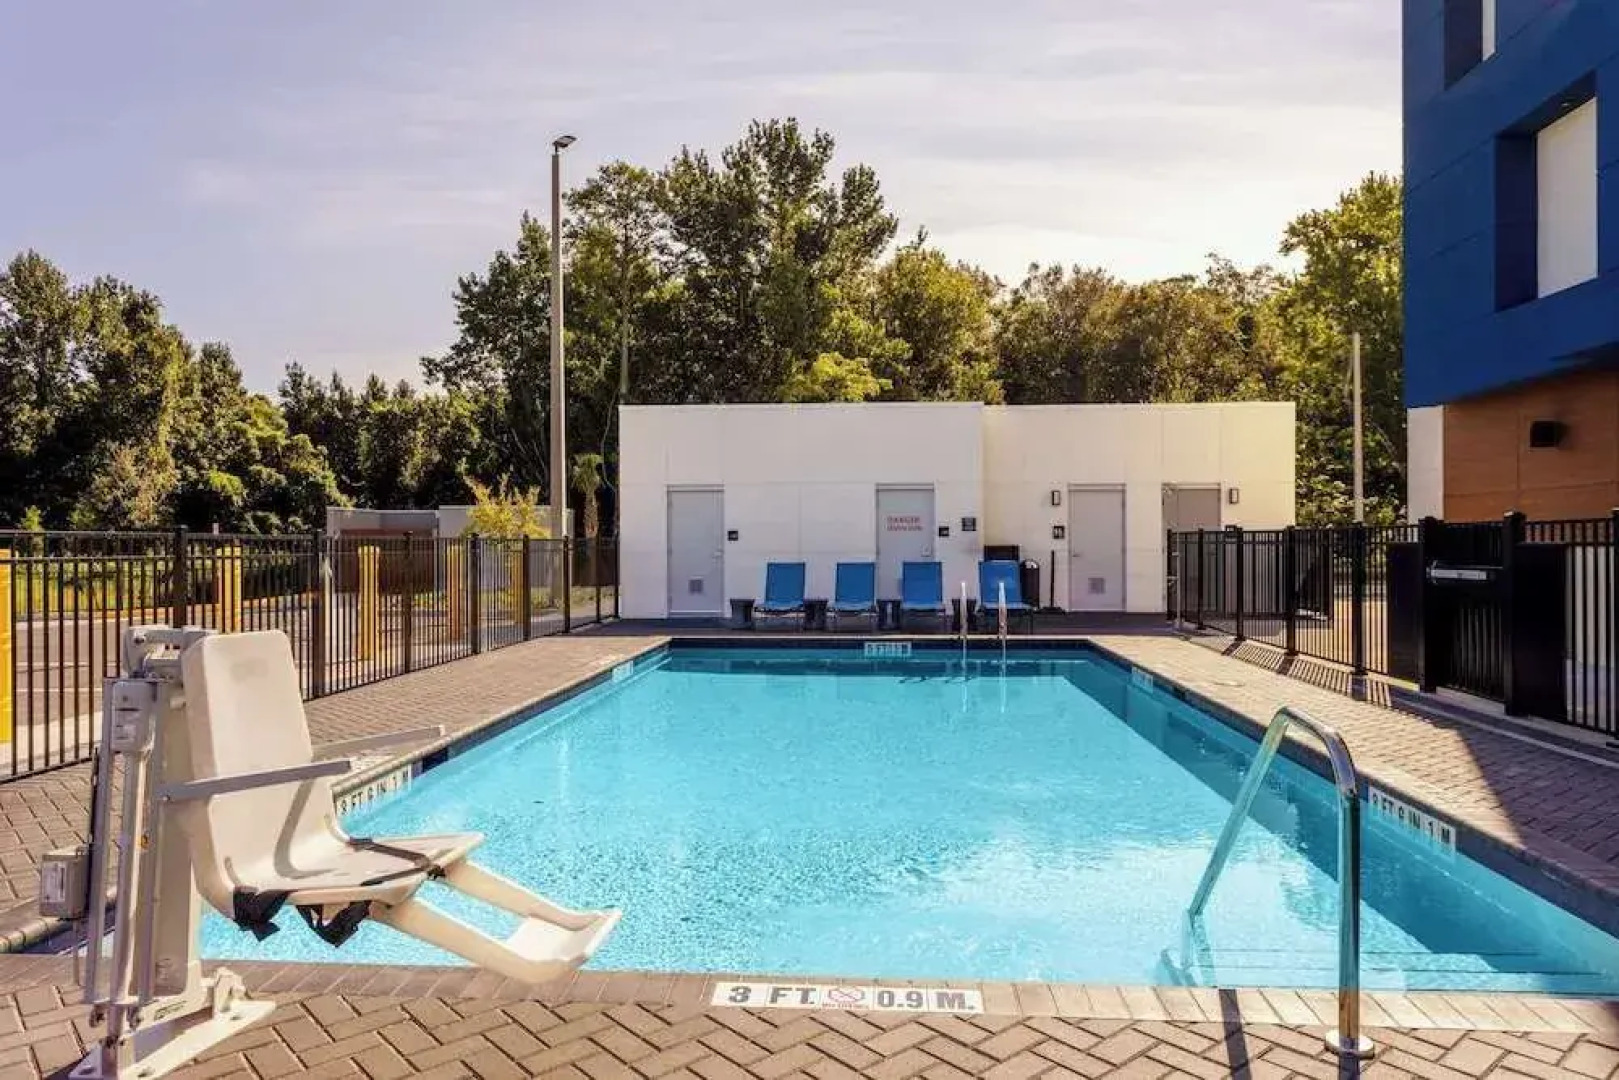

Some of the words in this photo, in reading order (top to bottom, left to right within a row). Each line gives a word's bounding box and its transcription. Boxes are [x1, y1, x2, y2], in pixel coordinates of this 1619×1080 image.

[729, 986, 751, 1003] 3
[770, 987, 817, 1005] FT.
[877, 990, 923, 1009] 0.9
[936, 992, 975, 1010] M.
